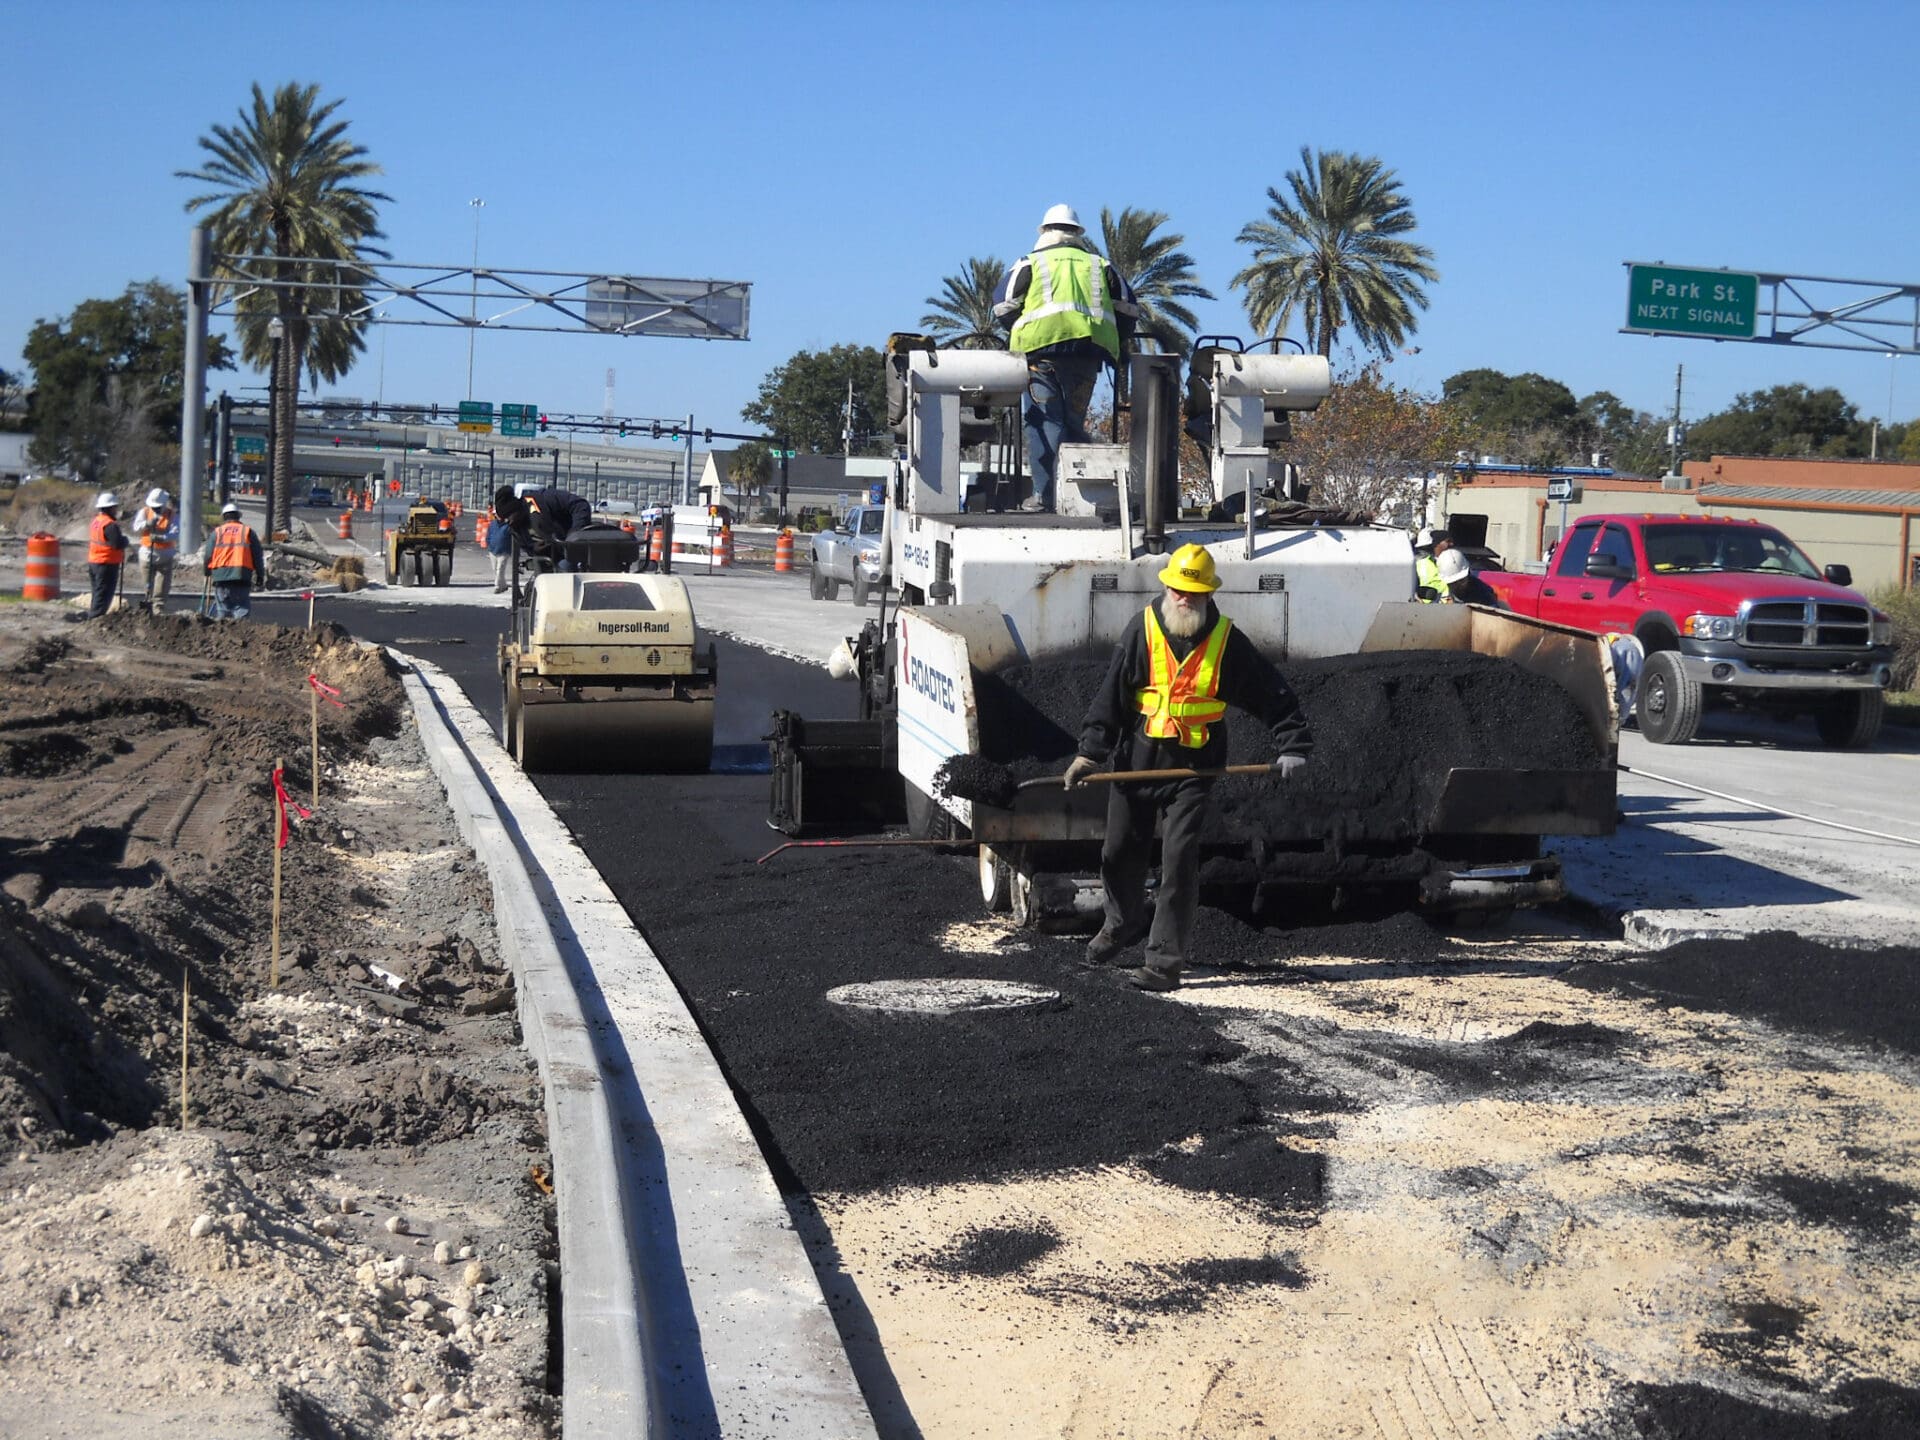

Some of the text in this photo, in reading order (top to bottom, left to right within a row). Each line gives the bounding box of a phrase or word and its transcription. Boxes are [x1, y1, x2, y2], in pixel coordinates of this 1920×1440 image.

[1650, 278, 1740, 302] Park St.
[1637, 303, 1745, 326] NEXT SIGNAL
[598, 622, 670, 635] Ingersoll-Rand
[911, 655, 956, 715] ROADTEC
